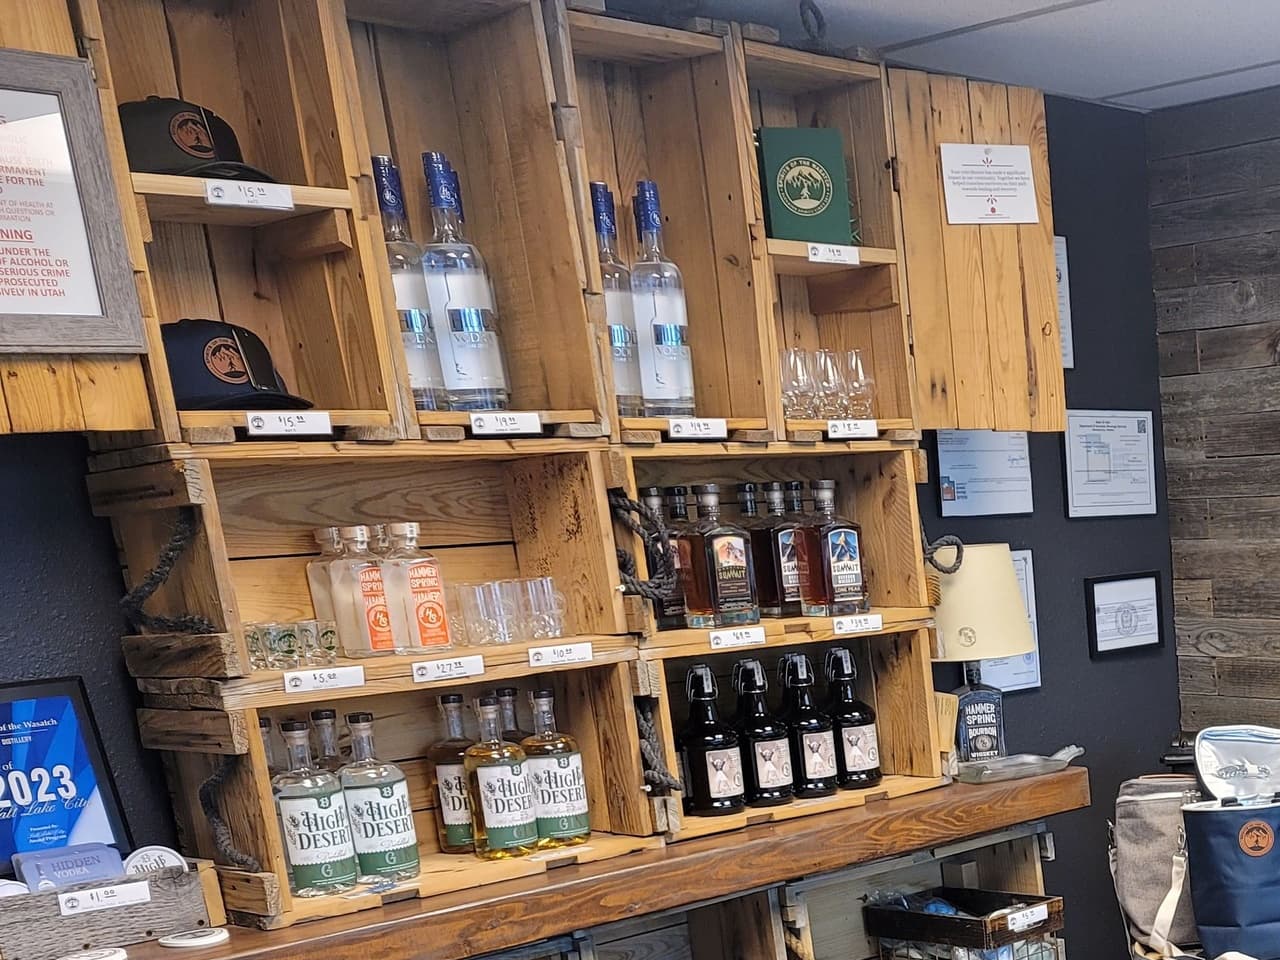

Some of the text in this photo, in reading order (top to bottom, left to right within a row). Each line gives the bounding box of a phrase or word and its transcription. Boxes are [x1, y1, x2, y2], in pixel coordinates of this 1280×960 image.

[6, 177, 45, 187] FOR THE
[6, 208, 44, 216] QUESTIONS
[33, 248, 50, 257] THE
[10, 258, 53, 267] ALCOHOL
[55, 259, 69, 268] OR
[0, 268, 70, 278] SERIOUS CRIME
[0, 278, 58, 287] PROSECUTED
[28, 289, 38, 297] IN
[40, 288, 66, 297] UTAH
[409, 566, 436, 577] HAMMER
[966, 703, 996, 715] HAMMER
[8, 722, 21, 730] the
[23, 718, 57, 729] Wasatch
[966, 714, 996, 725] SPRING
[968, 727, 997, 739] BOURBON
[970, 751, 999, 759] WHISKEY
[2, 761, 13, 770] of
[543, 765, 582, 790] HIGH
[540, 784, 586, 805] DESERT
[21, 801, 56, 816] Lake
[364, 795, 408, 822] HIGH
[301, 805, 345, 833] HIGH
[362, 814, 414, 839] DESERT
[298, 826, 350, 850] DESERT
[51, 855, 101, 871] HIDDEN
[54, 867, 90, 878] VODKA
